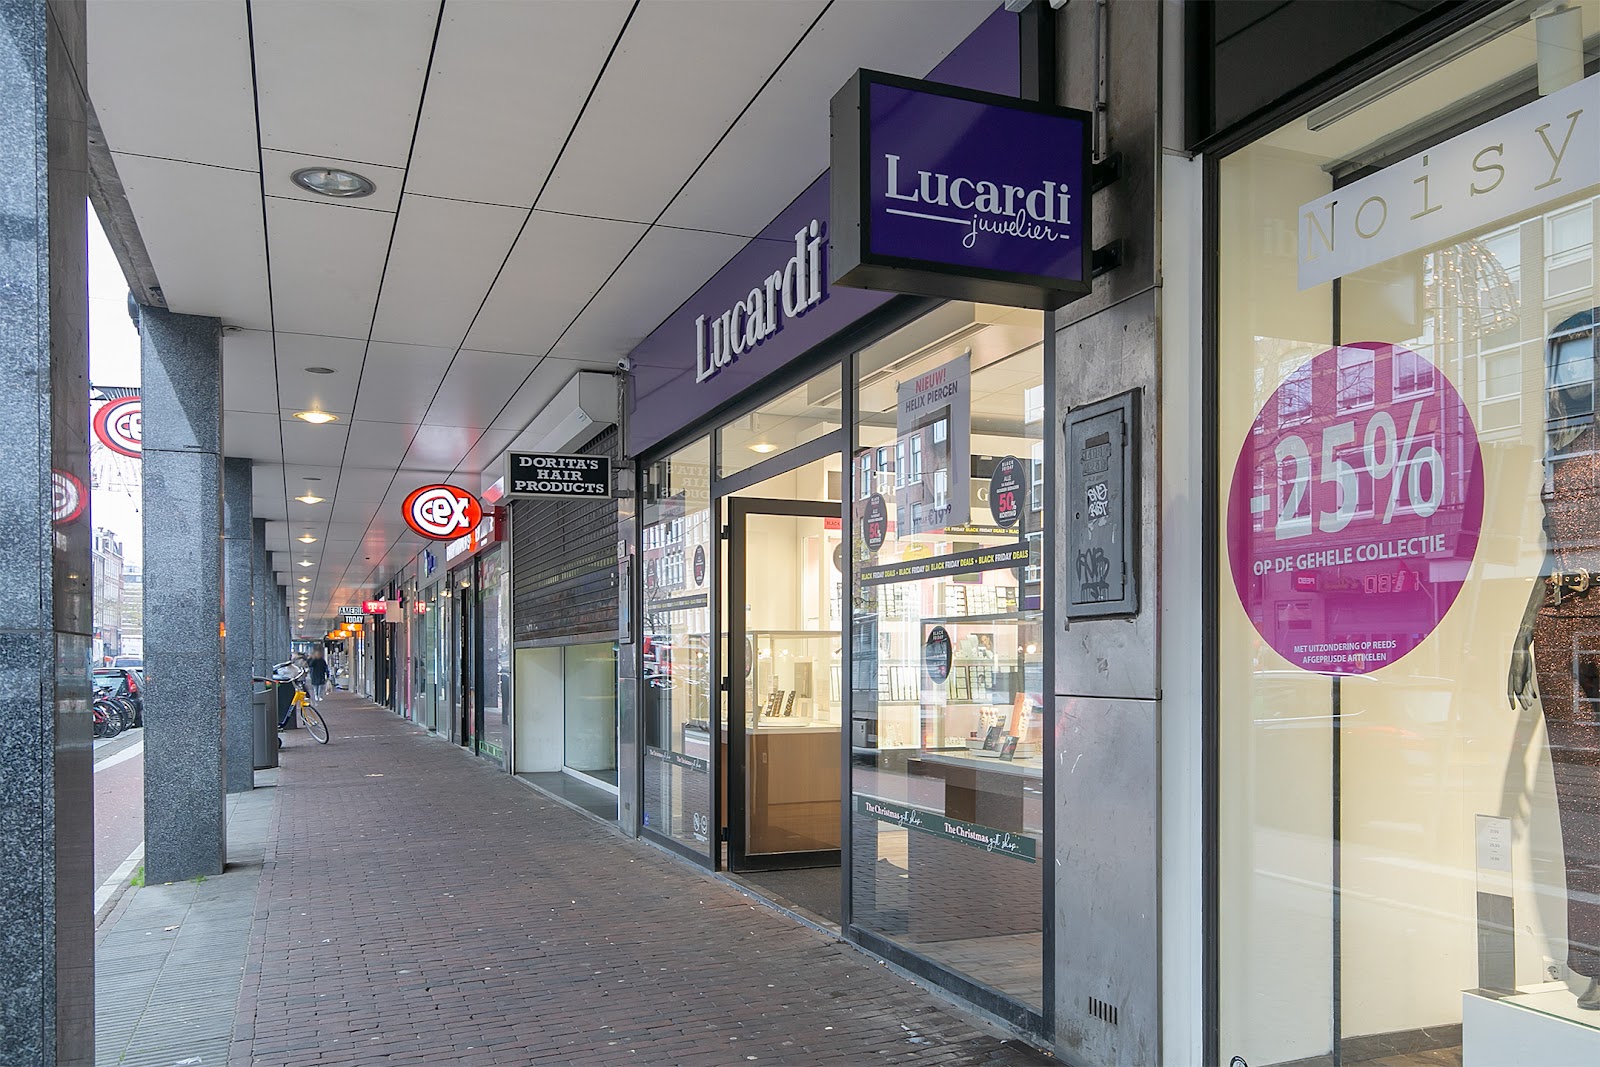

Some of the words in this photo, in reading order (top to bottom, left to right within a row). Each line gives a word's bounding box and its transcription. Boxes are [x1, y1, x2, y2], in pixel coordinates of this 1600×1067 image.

[885, 153, 1071, 224] Lucardi
[1304, 109, 1584, 262] Noisy
[962, 208, 1058, 248] juwelier
[695, 219, 822, 383] Lucardi
[915, 368, 947, 394] NIEUW!
[905, 395, 925, 413] HELIX
[927, 380, 958, 404] PIERCEN
[519, 457, 599, 470] DORITA'S
[1250, 400, 1445, 541] -25%
[537, 469, 583, 481] HAIR
[515, 480, 604, 493] PRODUCTS
[931, 562, 944, 570] BLACK
[945, 560, 960, 568] FRIDAY
[960, 557, 974, 566] DEALS
[979, 555, 995, 564] BLACK
[995, 552, 1012, 562] FRIDAY
[1012, 550, 1029, 559] DEALS
[1253, 560, 1273, 576] OP
[1275, 556, 1293, 573] DE
[1296, 547, 1353, 570] GEHELE
[1356, 534, 1446, 563] COLLECTIE
[912, 566, 925, 574] FRIDAY
[345, 615, 364, 623] TODAY
[1294, 645, 1308, 653] MET
[1309, 642, 1360, 652] UITZONDERING
[1361, 641, 1371, 649] OP
[1373, 640, 1397, 649] REEDS
[1348, 653, 1387, 662] ARTIKELEN
[865, 802, 875, 812] The
[875, 805, 900, 819] Christmas
[944, 822, 956, 834] The
[956, 826, 989, 843] Christmas
